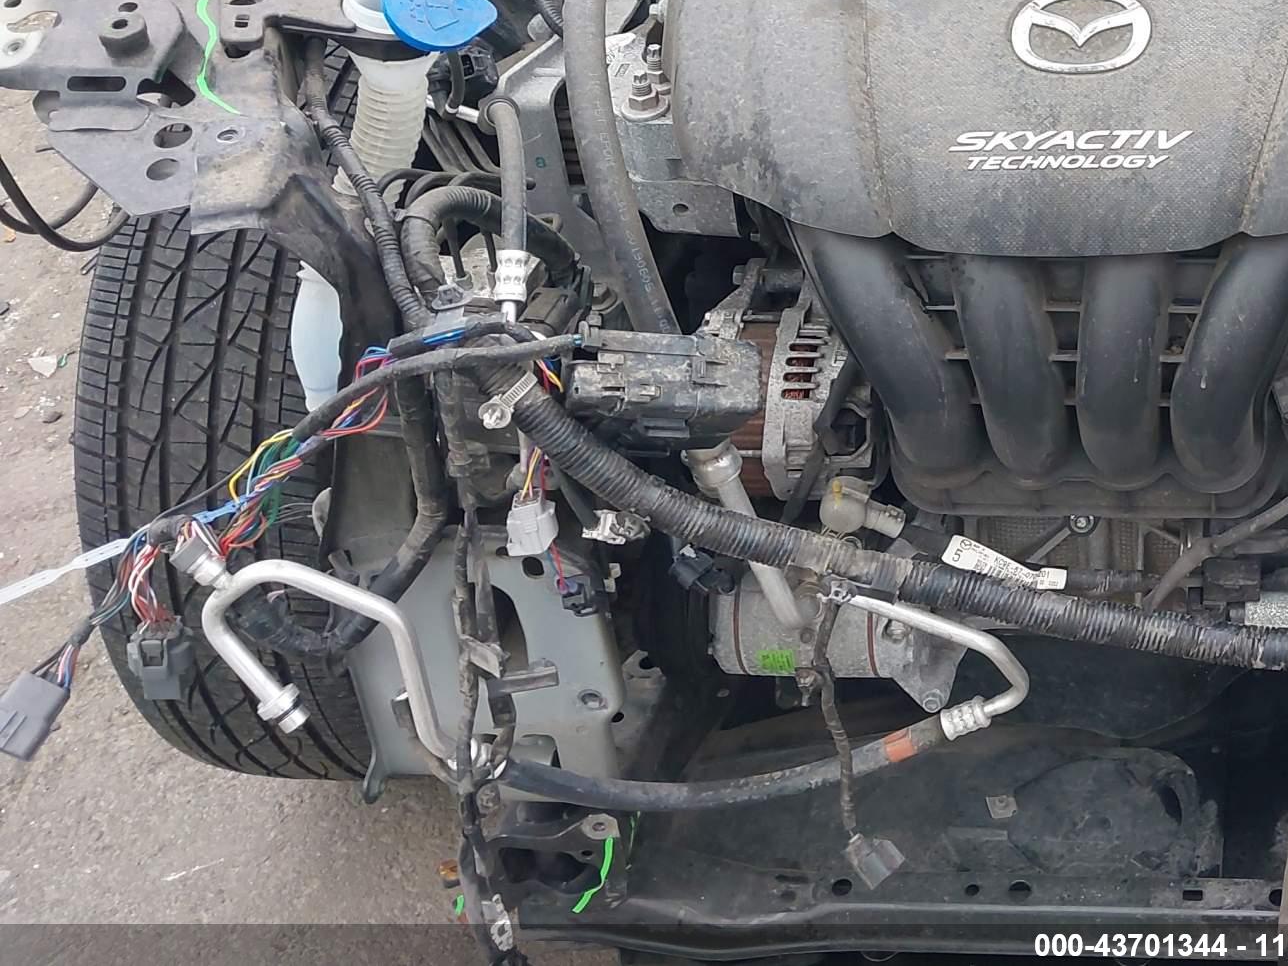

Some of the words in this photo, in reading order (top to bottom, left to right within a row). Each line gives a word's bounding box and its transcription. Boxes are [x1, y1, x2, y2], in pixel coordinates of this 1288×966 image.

[949, 130, 1194, 152] SKYACTIV
[966, 154, 1170, 171] TECHNOLOGY
[951, 547, 963, 563] 5
